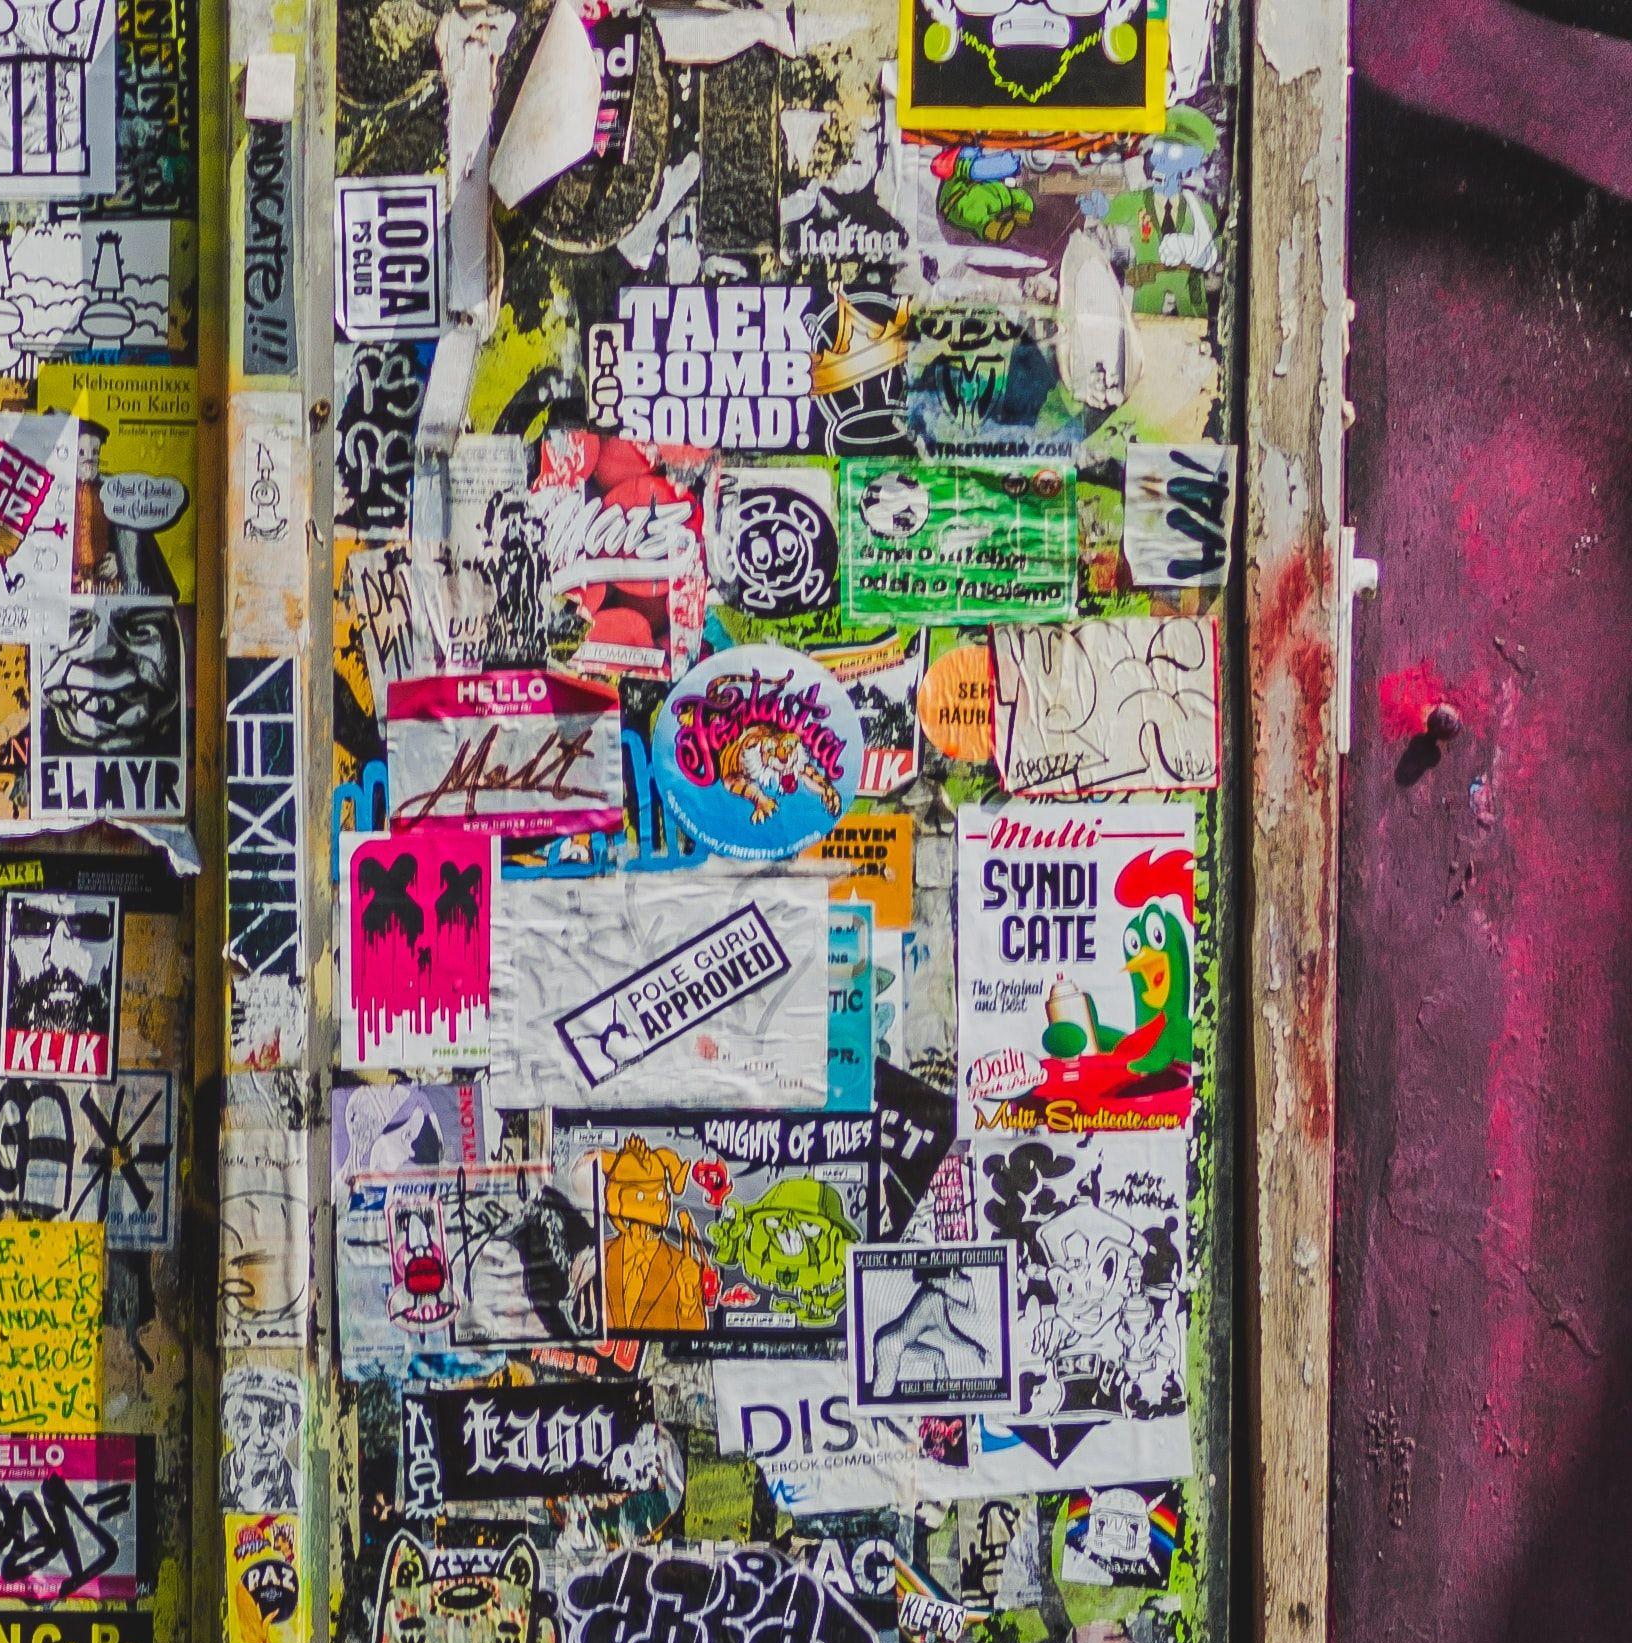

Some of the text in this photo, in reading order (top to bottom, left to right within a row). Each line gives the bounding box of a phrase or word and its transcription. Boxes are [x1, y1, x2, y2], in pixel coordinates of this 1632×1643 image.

[376, 195, 431, 319] LOGA
[619, 286, 813, 352] TAEK
[623, 351, 813, 397] BOMB
[108, 395, 141, 412] Don
[620, 397, 811, 450] SQUAD!
[457, 678, 548, 703] HELLO
[988, 816, 1104, 850] Multi
[982, 859, 1099, 911] SYNDI
[1001, 915, 1097, 964] CATE
[627, 920, 760, 1012] POLE GURU
[972, 978, 1044, 1000] The Original
[638, 941, 776, 1042] APPROVED
[10, 1032, 103, 1073] KLIK
[971, 1047, 1027, 1081] Daily
[704, 1118, 781, 1165] KNIGHTS
[788, 1119, 817, 1163] OF
[822, 1118, 873, 1160] TALES
